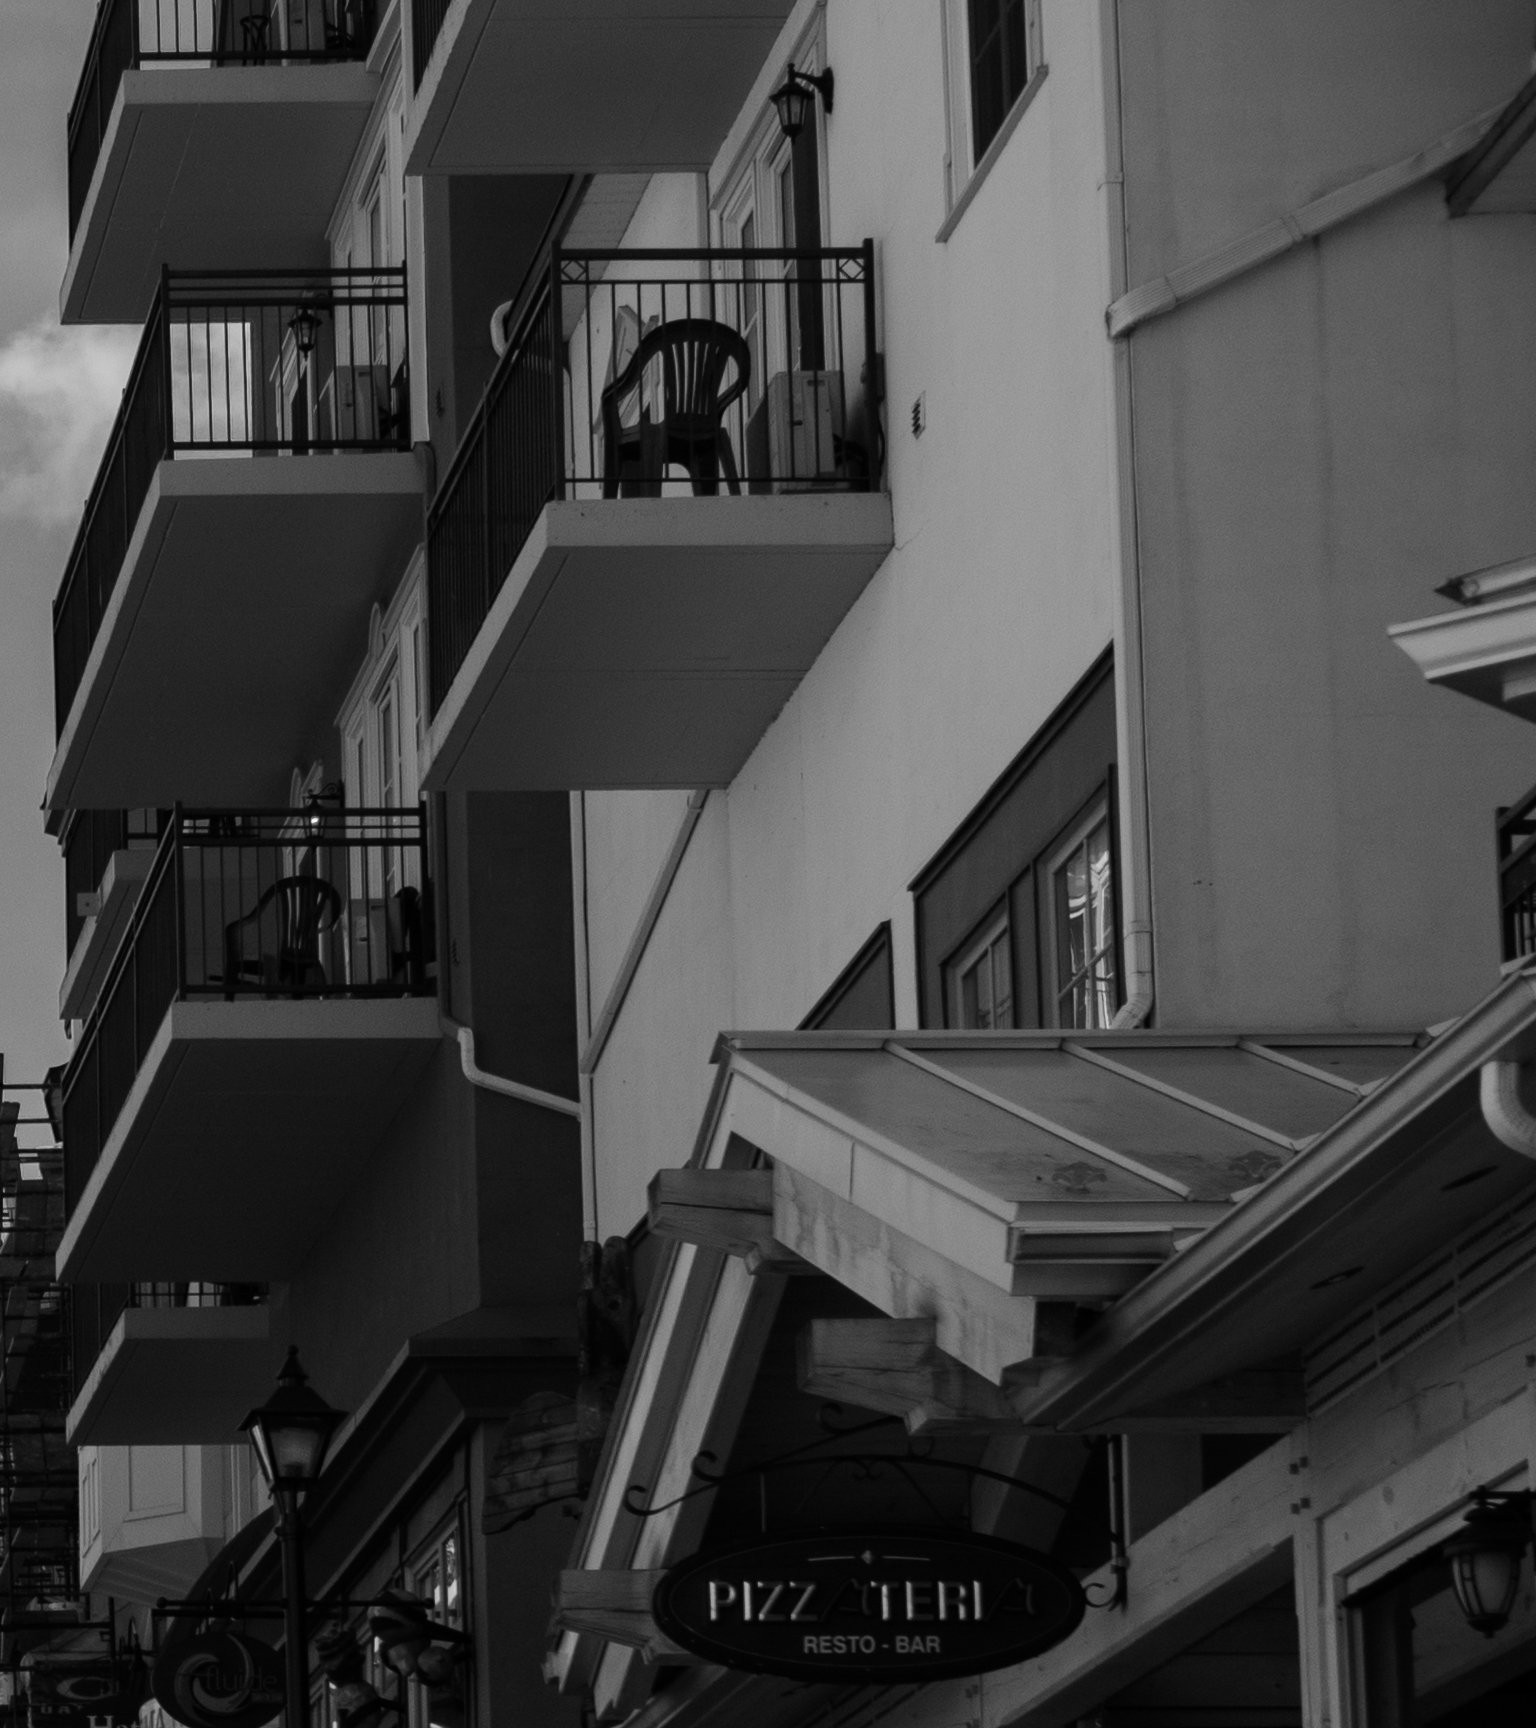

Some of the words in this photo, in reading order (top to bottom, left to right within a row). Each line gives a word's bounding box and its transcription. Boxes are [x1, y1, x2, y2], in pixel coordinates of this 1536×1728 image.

[803, 1635, 876, 1654] RESTO
[894, 1635, 941, 1654] BAR
[204, 1664, 279, 1692] fluide
